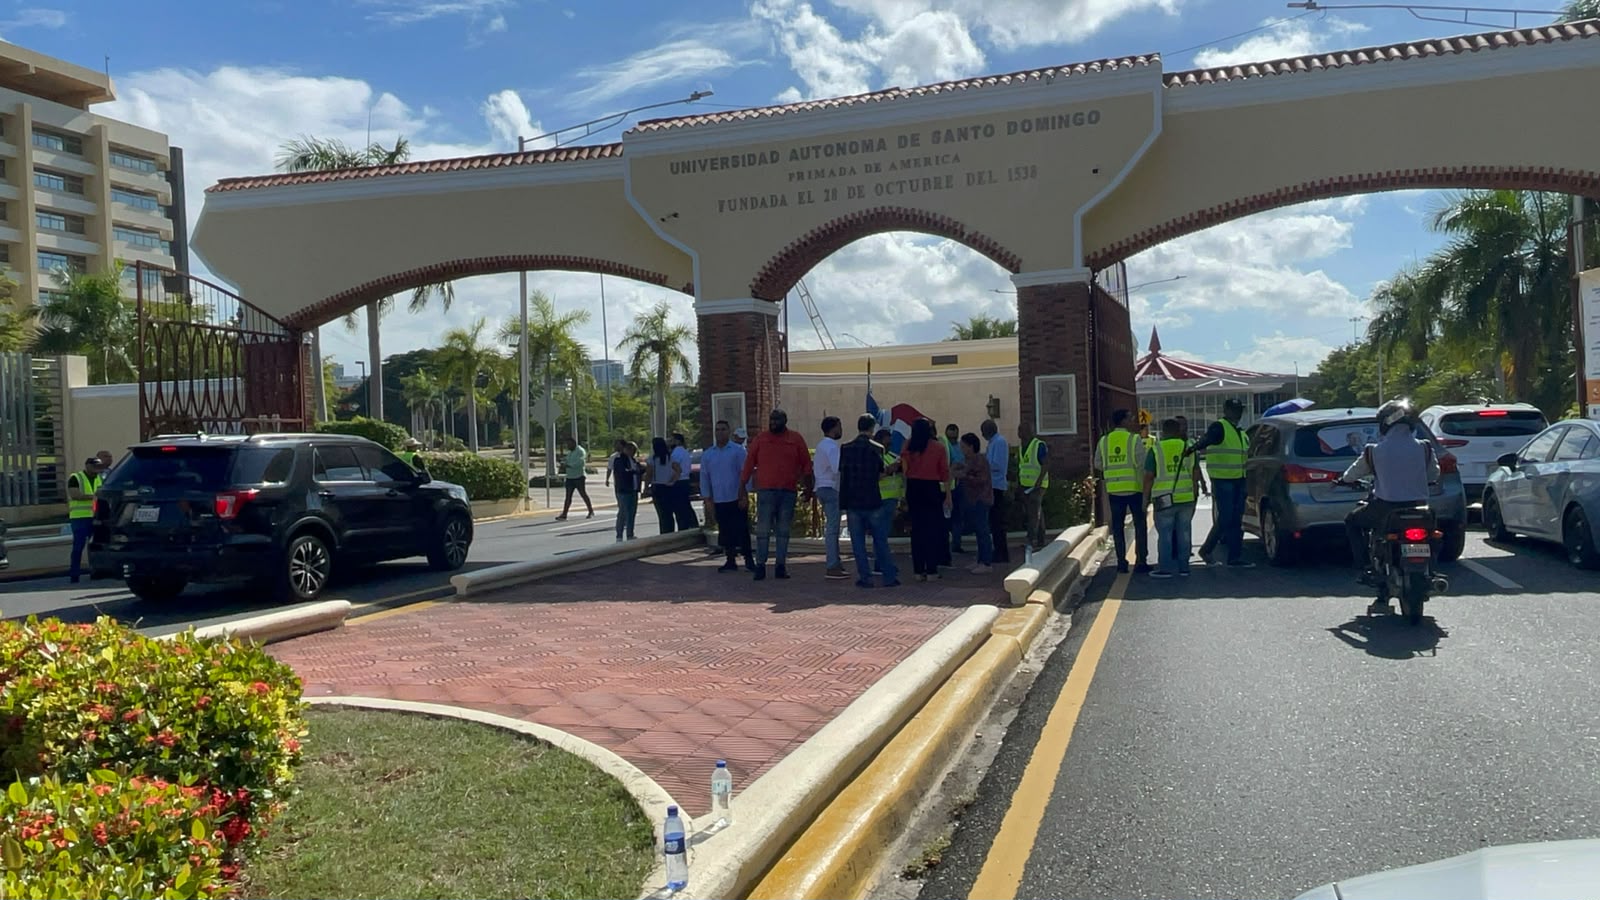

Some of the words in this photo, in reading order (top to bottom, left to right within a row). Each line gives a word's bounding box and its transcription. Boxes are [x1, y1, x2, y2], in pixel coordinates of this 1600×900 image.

[670, 150, 780, 175] UNIVERSIDAD
[789, 138, 887, 162] AUTONOMA
[897, 133, 921, 149] DE
[931, 123, 995, 145] SANTO
[1006, 110, 1101, 136] DOMINGO
[718, 194, 788, 213] FUNDADA
[797, 190, 815, 205] EL
[823, 188, 838, 202] 28
[847, 184, 865, 199] DE
[875, 174, 954, 196] OCTUBRE
[966, 169, 999, 187] DEL
[1007, 164, 1038, 182] 1538
[788, 166, 857, 182] PRIMADA
[864, 162, 882, 174] DE
[888, 153, 961, 171] AMERICA
